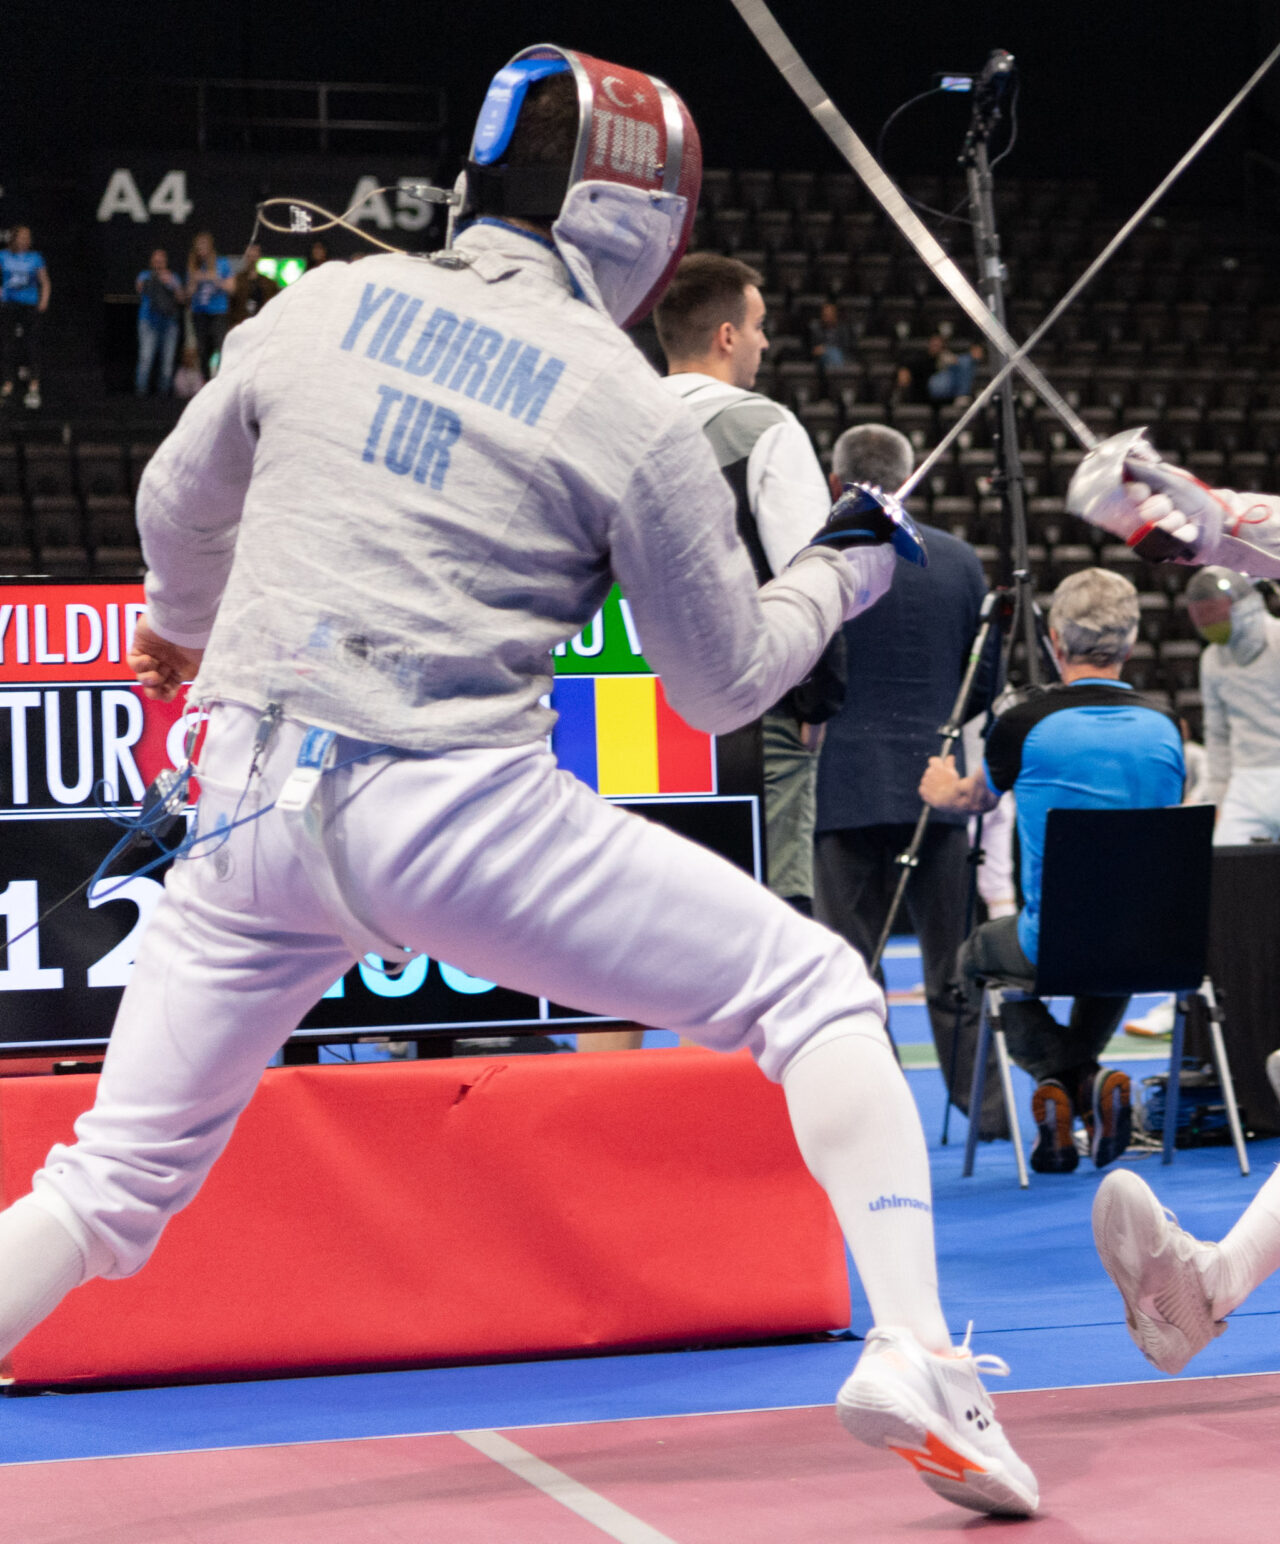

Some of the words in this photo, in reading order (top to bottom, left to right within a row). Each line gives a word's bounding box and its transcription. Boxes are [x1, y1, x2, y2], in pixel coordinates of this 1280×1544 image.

[592, 108, 659, 181] TUR
[97, 168, 194, 224] A4
[348, 175, 433, 231] A5
[340, 283, 567, 427] YILDIRIM
[362, 384, 462, 490] TUR
[0, 689, 146, 805] TUR
